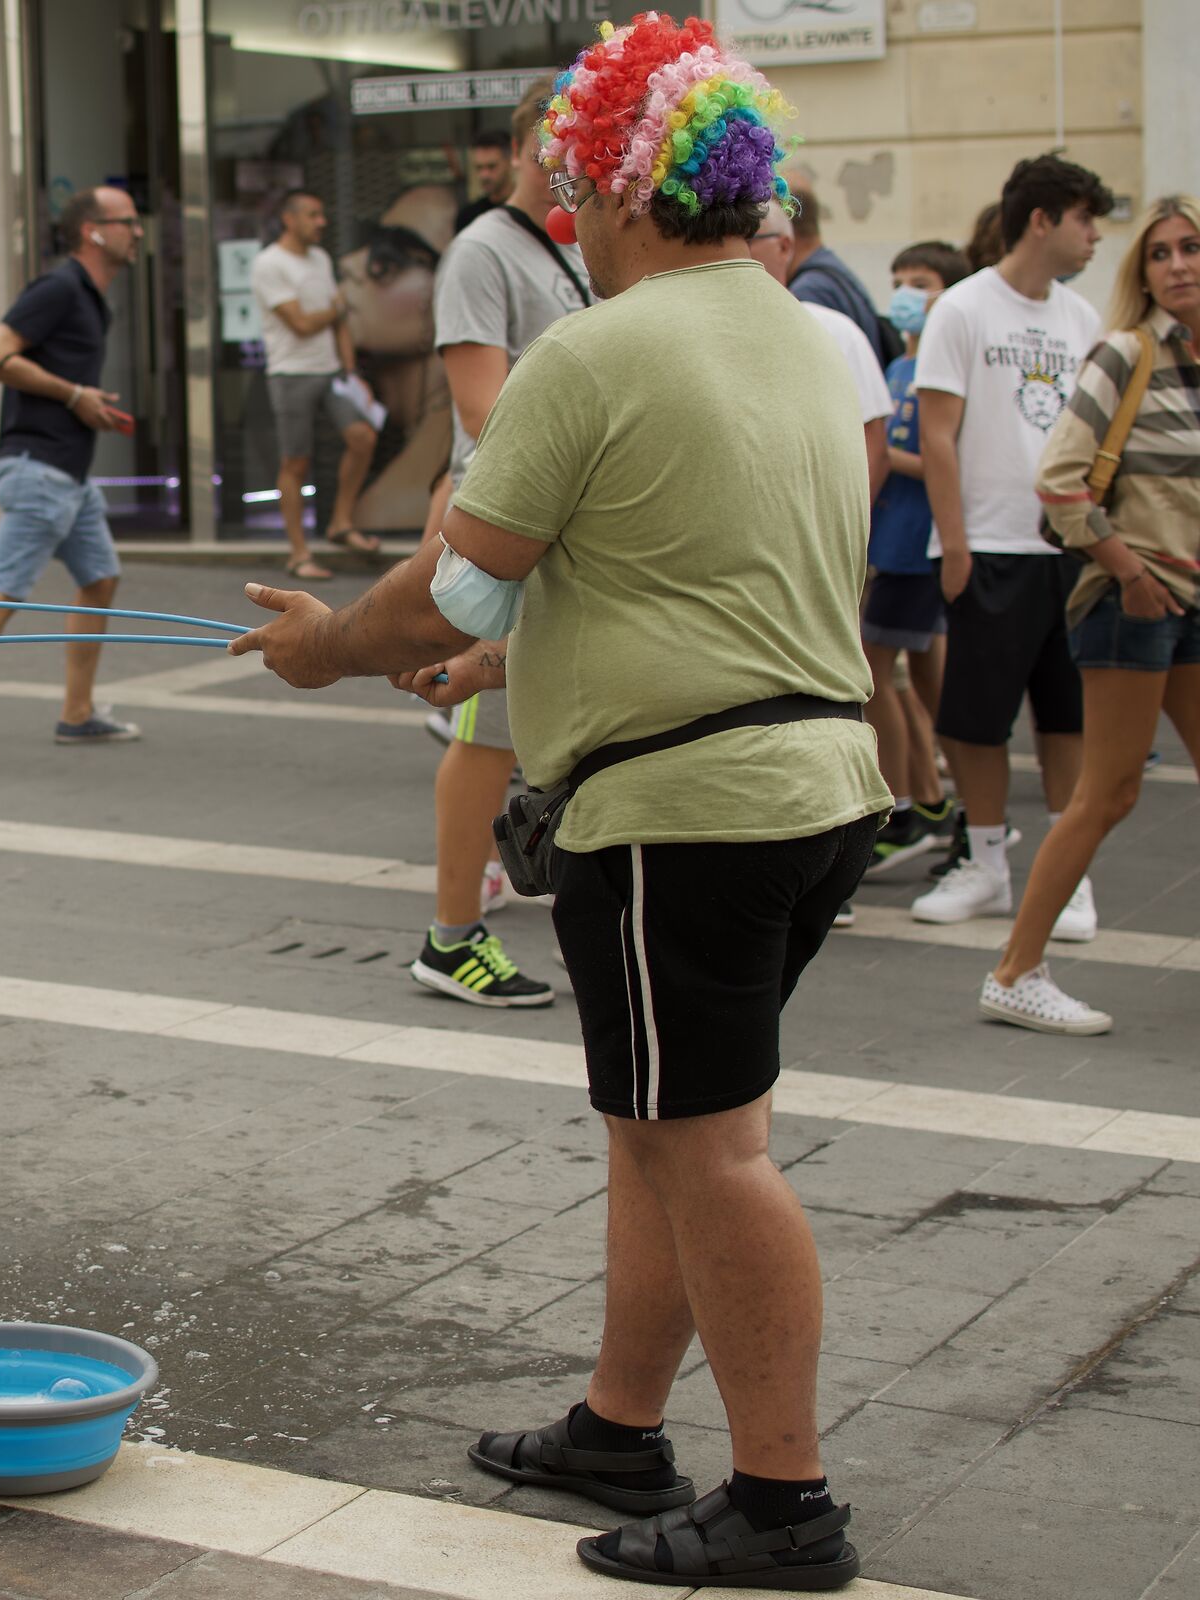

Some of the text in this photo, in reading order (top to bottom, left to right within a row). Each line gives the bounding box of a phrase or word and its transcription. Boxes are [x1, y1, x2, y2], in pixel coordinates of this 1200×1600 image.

[299, 0, 610, 37] OTTICA LEVANTE
[792, 26, 873, 49] LEVANTE
